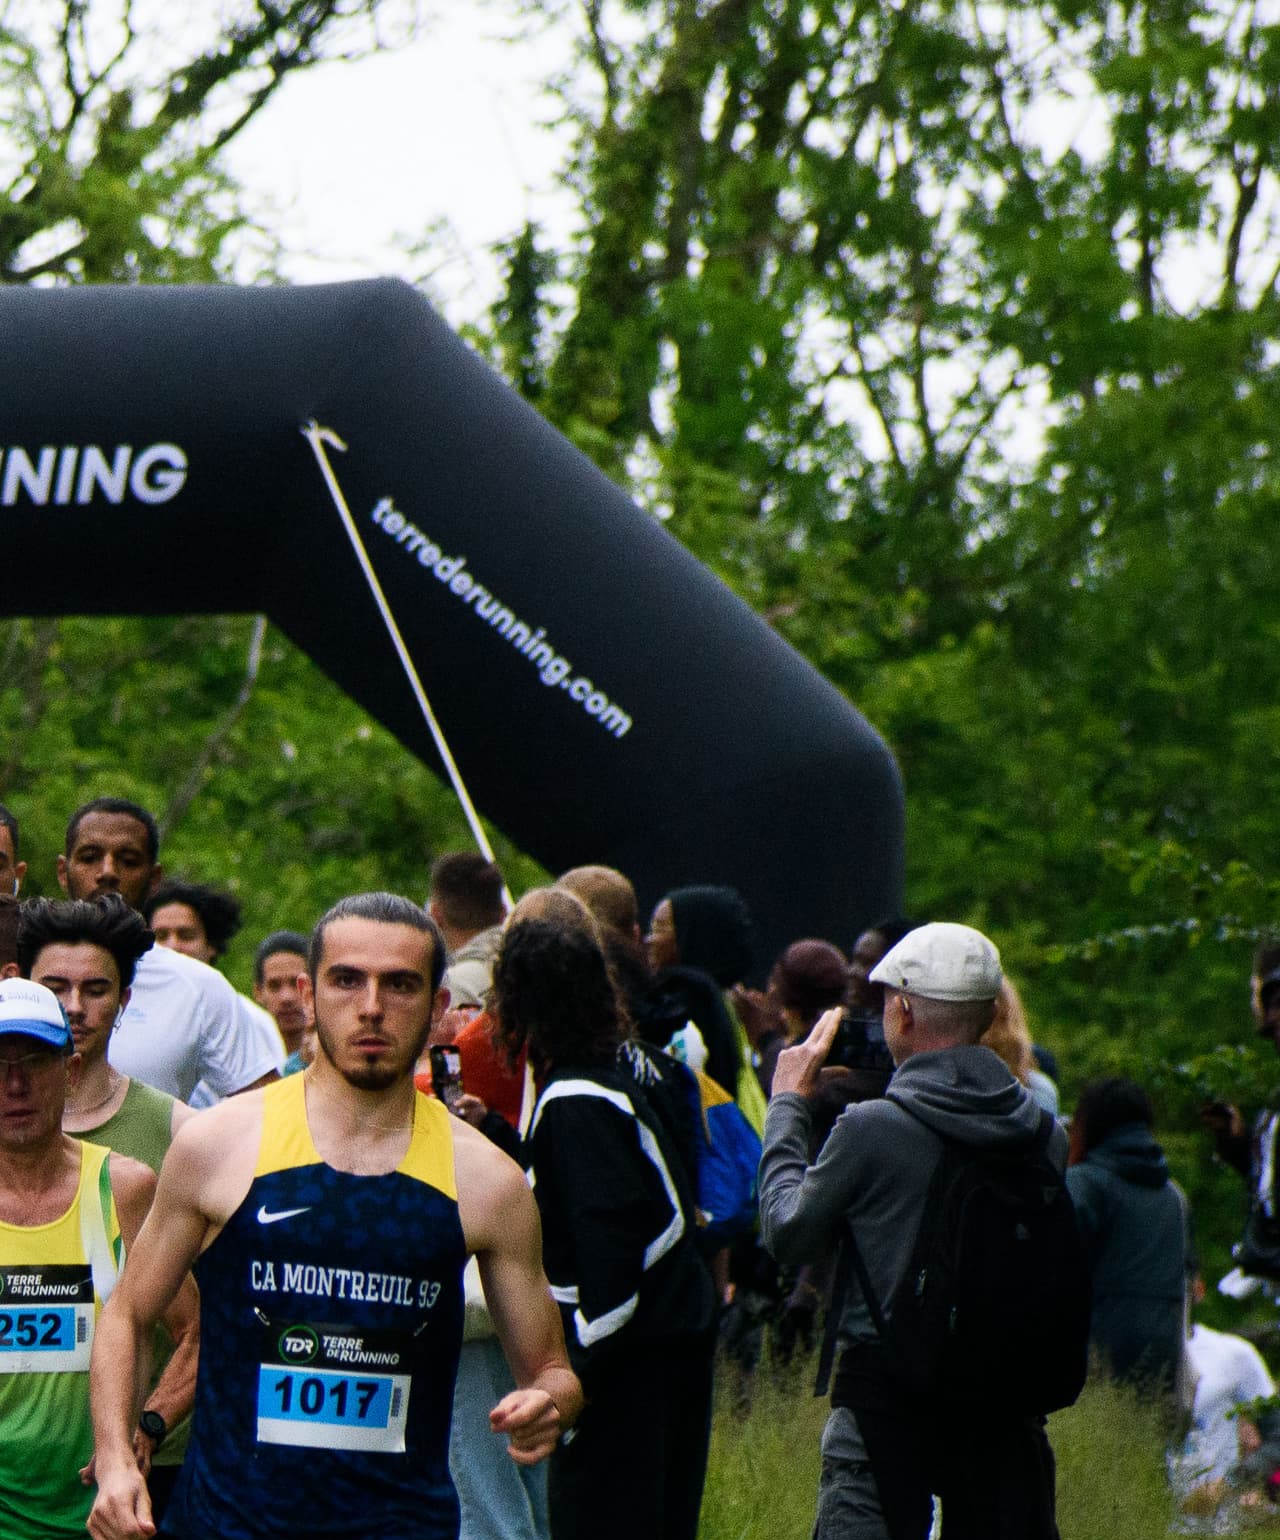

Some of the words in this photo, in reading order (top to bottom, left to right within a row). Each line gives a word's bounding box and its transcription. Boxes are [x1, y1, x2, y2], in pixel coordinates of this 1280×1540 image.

[371, 497, 633, 738] terrederunning.com
[6, 1275, 42, 1286] TERRE
[251, 1260, 277, 1292] CA
[281, 1262, 414, 1308] MONTREUIL
[11, 1286, 23, 1295] DE
[22, 1284, 80, 1297] RUNNING
[284, 1337, 314, 1354] TDR
[322, 1335, 364, 1350] TERRE
[326, 1349, 340, 1359] DE
[339, 1350, 400, 1366] RUNNING
[274, 1375, 379, 1419] 1017
